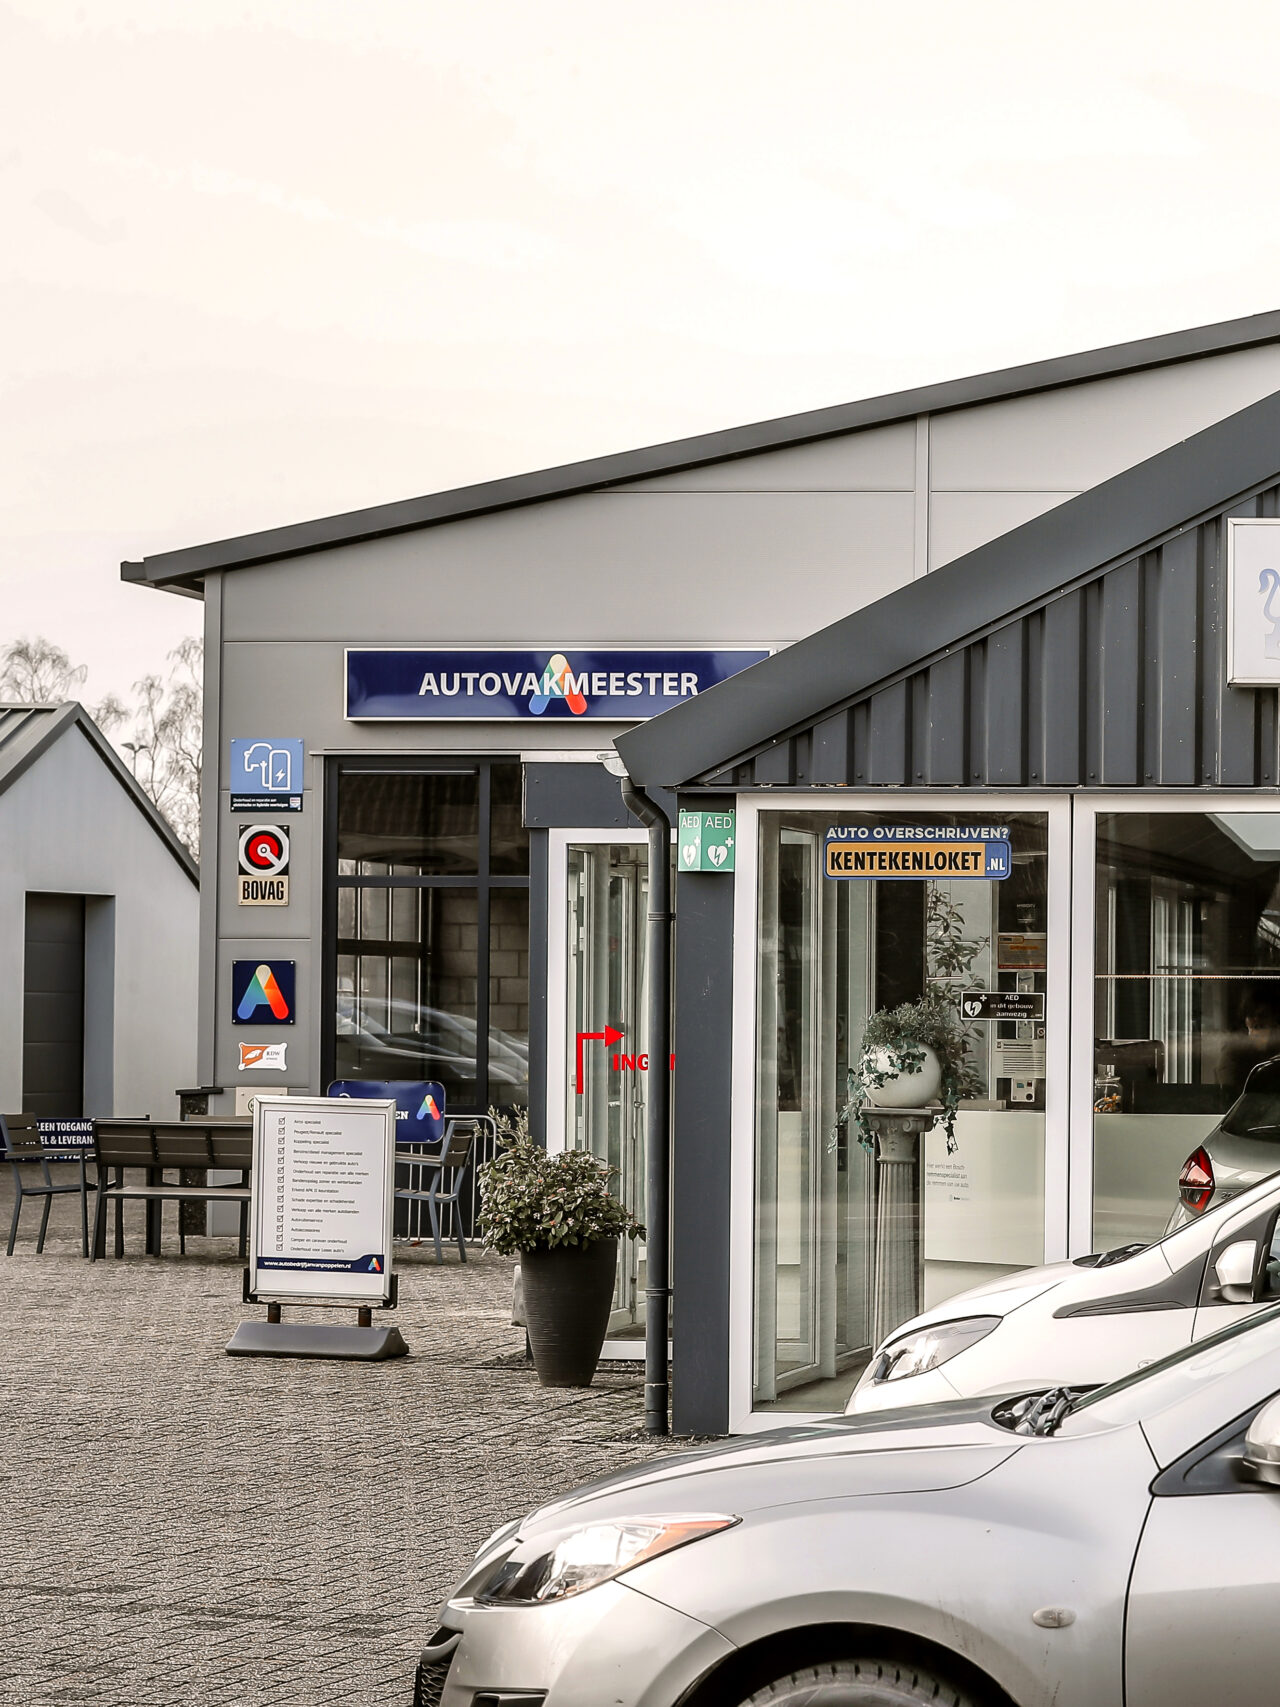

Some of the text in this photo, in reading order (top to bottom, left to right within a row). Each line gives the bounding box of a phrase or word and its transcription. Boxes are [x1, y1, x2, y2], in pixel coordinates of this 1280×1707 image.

[418, 672, 698, 697] AUTOVAKMEESTER
[681, 816, 700, 829] AED
[705, 816, 733, 829] AED
[827, 827, 1009, 839] AUTO OVERSCHRIJVEN?
[831, 851, 1006, 871] KENTEKENLOKET .NL
[243, 880, 285, 901] BOVAG
[56, 1122, 93, 1132] TOEGANG
[50, 1135, 57, 1145] &
[58, 1135, 95, 1145] LEVERAN
